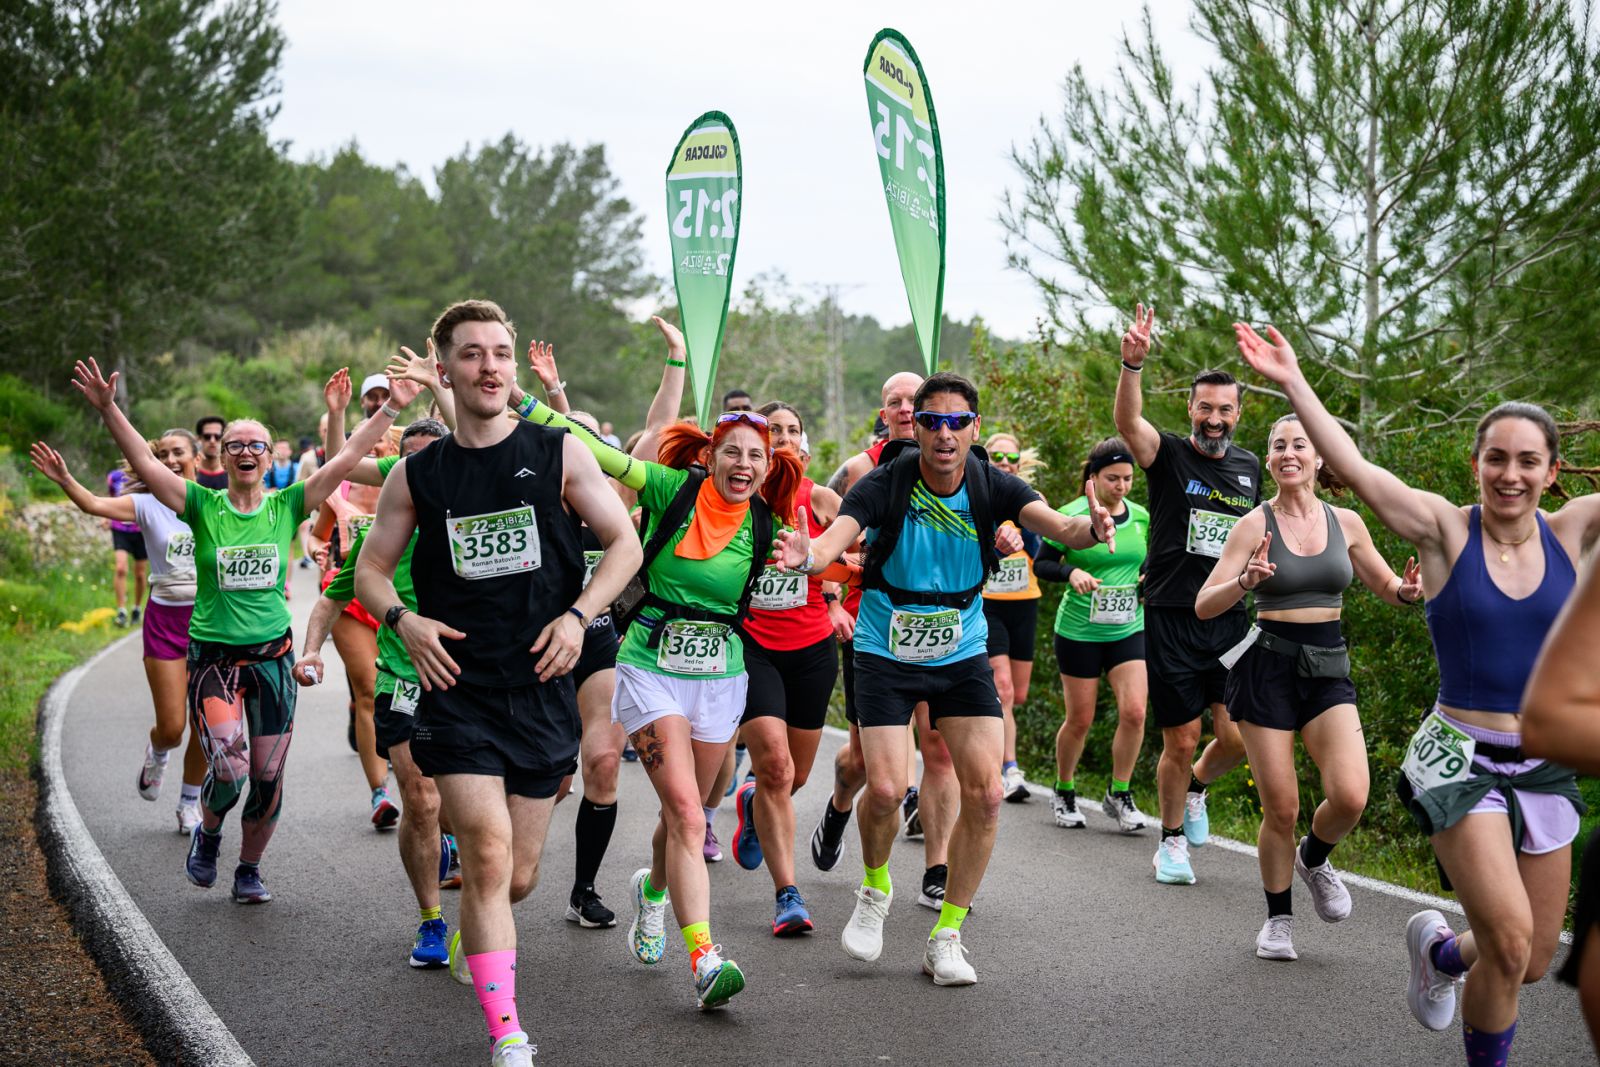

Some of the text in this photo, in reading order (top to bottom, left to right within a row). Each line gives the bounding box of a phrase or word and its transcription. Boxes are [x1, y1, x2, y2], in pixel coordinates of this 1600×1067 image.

[470, 519, 489, 535] 22
[505, 513, 531, 525] IBIZA
[463, 529, 528, 561] 3583
[233, 549, 247, 559] 22
[471, 554, 522, 568] Roman Batovkin
[226, 558, 272, 576] 4026
[990, 569, 1023, 583] 4281
[1098, 597, 1134, 612] 3382
[909, 617, 926, 628] 22
[939, 615, 958, 624] IBIZA
[680, 624, 698, 636] 22
[898, 627, 954, 648] 2759
[668, 635, 721, 658] 3638
[1413, 734, 1464, 779] 4079
